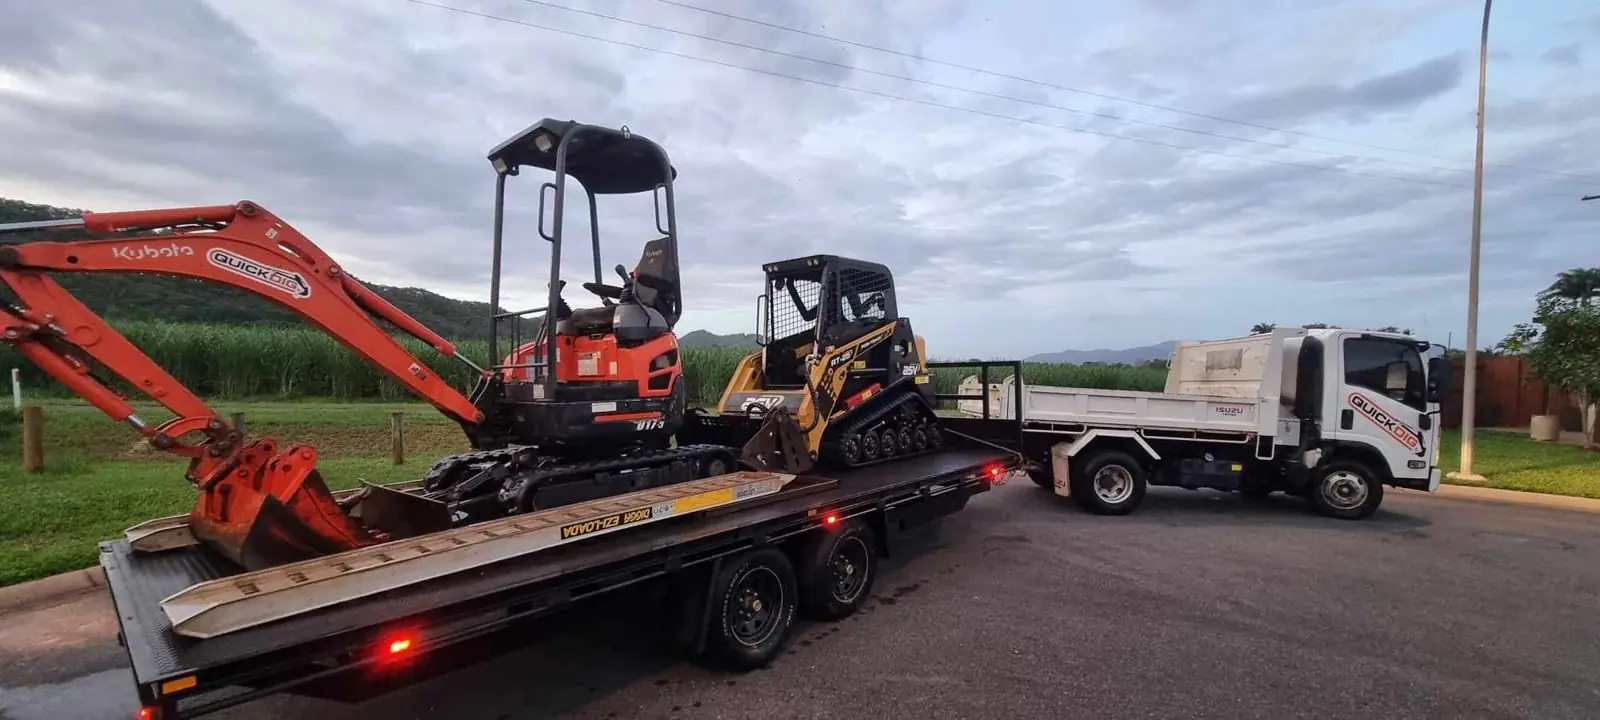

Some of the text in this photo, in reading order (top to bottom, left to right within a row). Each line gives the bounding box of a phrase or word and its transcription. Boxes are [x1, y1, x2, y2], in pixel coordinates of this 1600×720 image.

[112, 243, 194, 260] Kubota
[1352, 395, 1418, 448] QUICKDIG
[623, 507, 651, 524] DIGGA
[563, 515, 620, 538] EZI-LOADA
